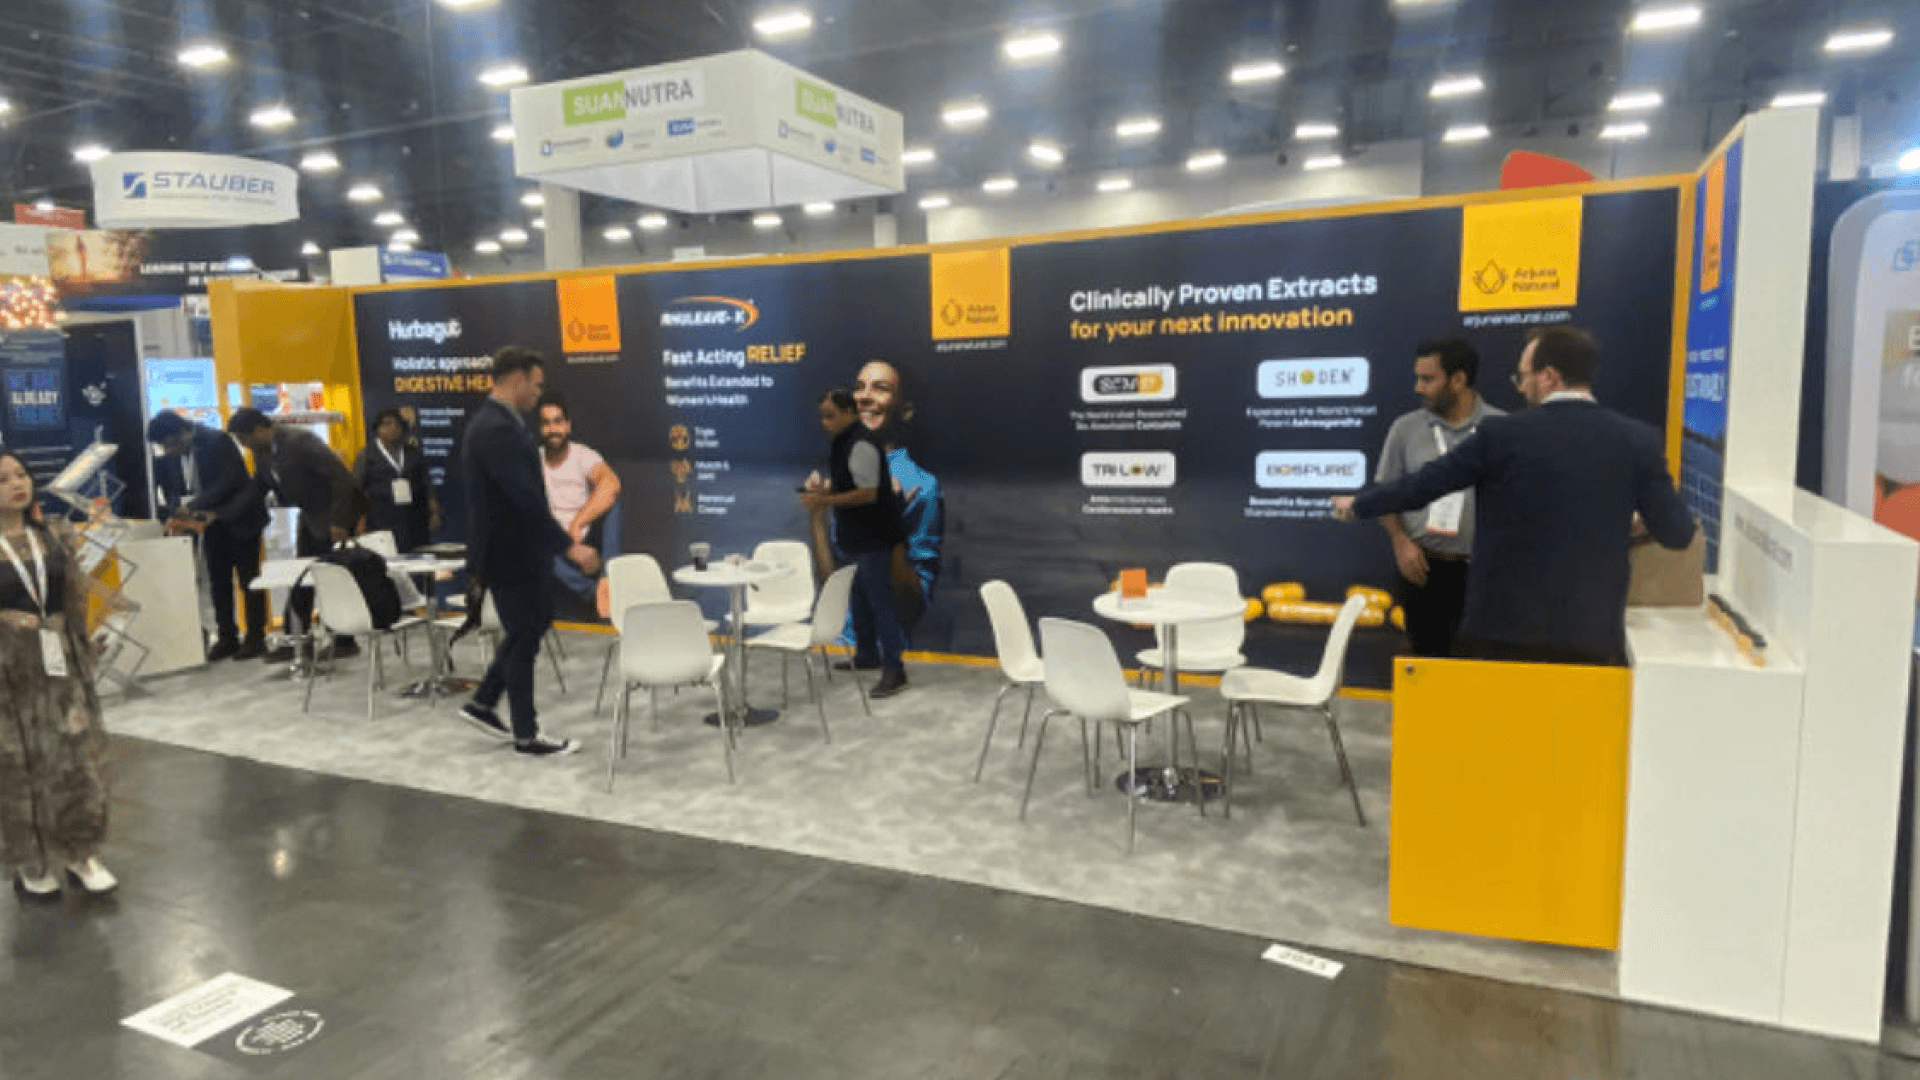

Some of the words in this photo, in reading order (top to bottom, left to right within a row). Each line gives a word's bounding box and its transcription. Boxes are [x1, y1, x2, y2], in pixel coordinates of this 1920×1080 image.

[152, 170, 276, 194] STAUBER
[1070, 285, 1174, 314] Clinically
[1180, 281, 1262, 305] Proven
[1268, 272, 1378, 300] Extracts
[1070, 319, 1101, 340] for
[1105, 318, 1156, 344] your
[1160, 311, 1213, 334] next
[662, 349, 694, 366] Fast
[696, 348, 745, 370] Acting
[746, 342, 805, 363] RELIEF
[394, 374, 464, 393] DIGESTIVE
[466, 373, 494, 392] HEA
